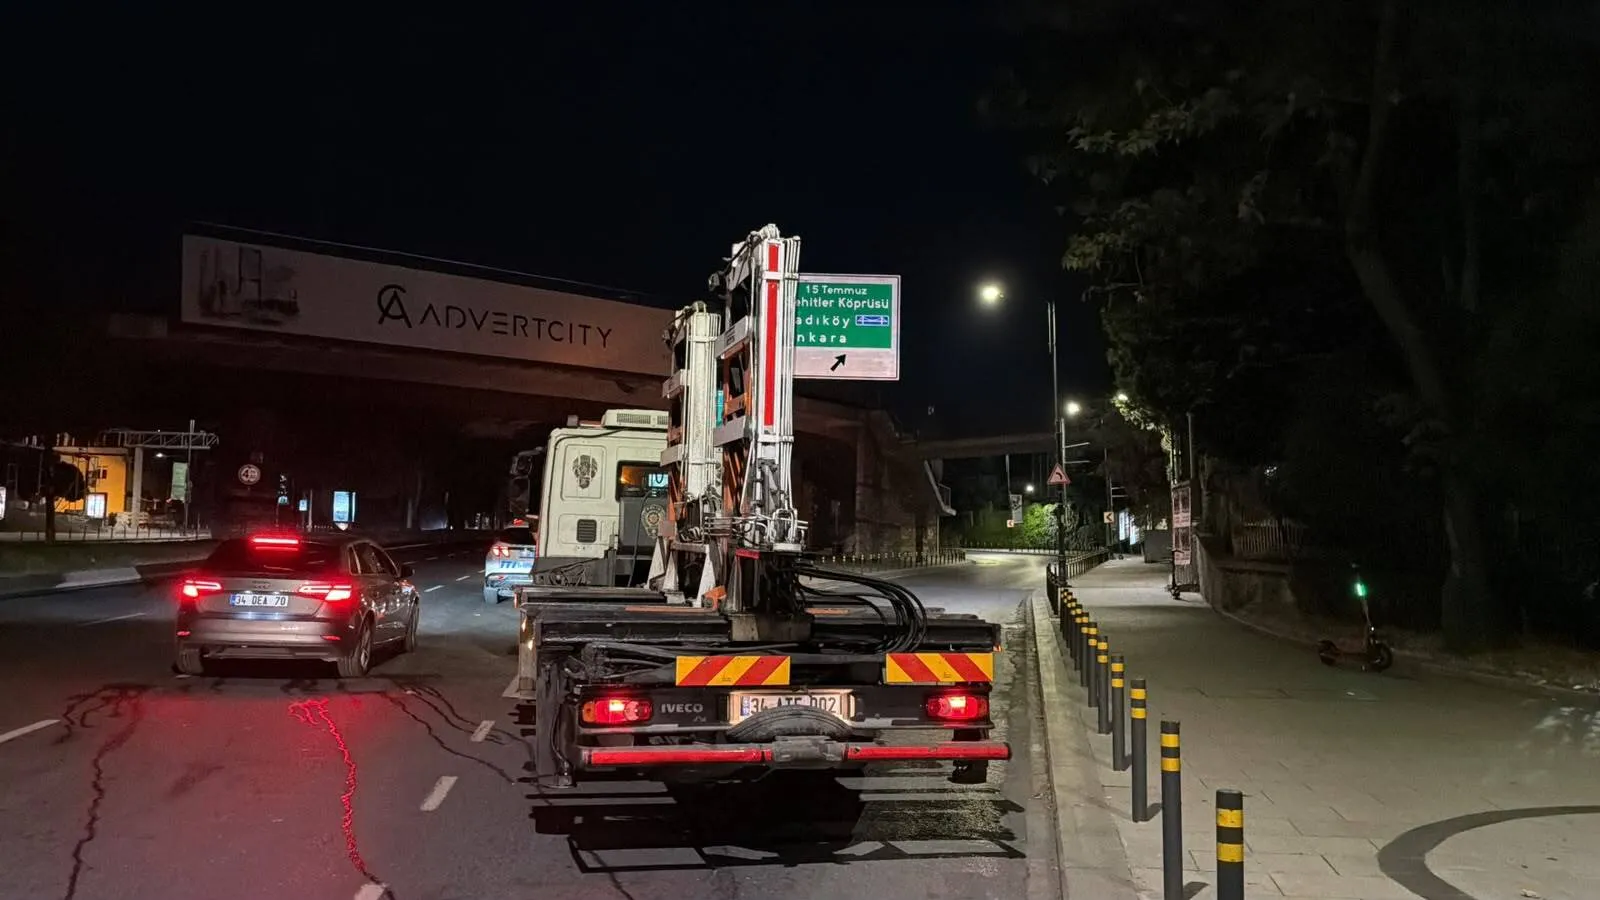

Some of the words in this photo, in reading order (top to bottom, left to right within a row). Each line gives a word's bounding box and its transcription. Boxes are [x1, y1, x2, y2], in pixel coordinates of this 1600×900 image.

[806, 285, 819, 294] 15
[821, 285, 868, 295] Temmuz
[796, 297, 834, 308] ehitler
[838, 297, 889, 310] Köprüsü
[419, 303, 613, 349] ADVERTCITY
[795, 314, 850, 329] adıköy
[796, 332, 847, 343] nkara
[236, 595, 246, 605] 34
[251, 595, 268, 605] DEA
[274, 596, 286, 606] 70
[661, 703, 704, 713] IVECO
